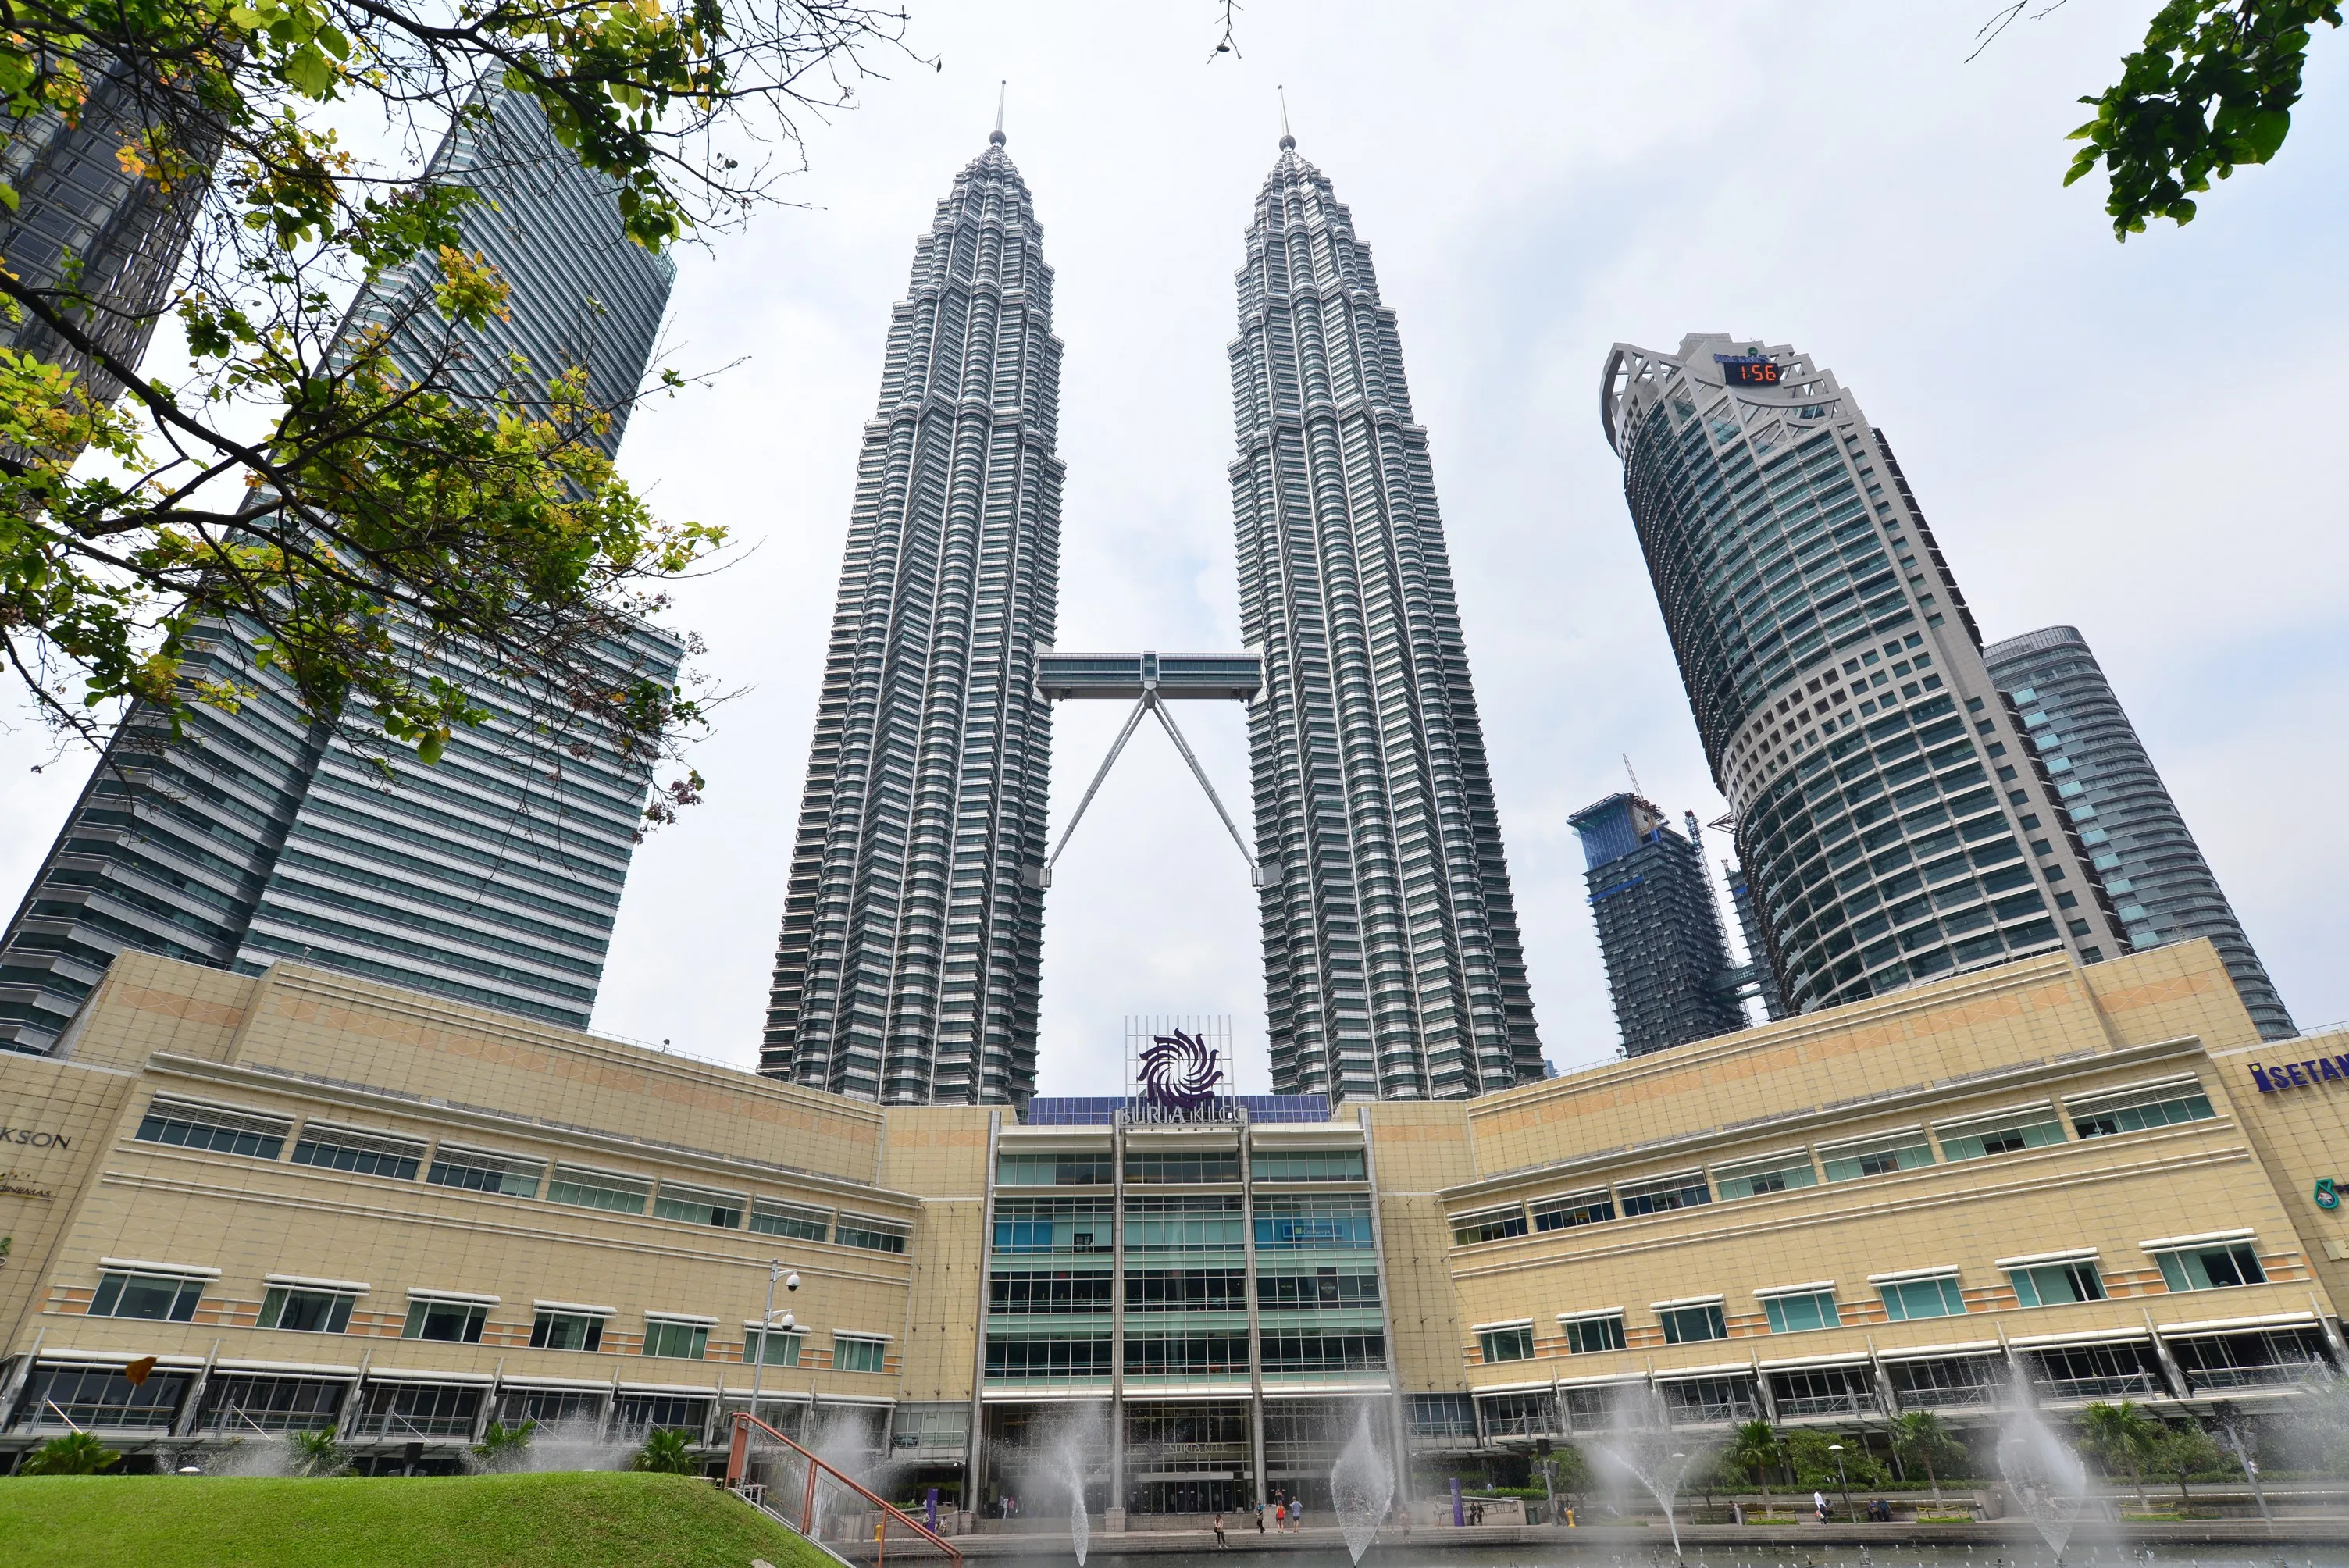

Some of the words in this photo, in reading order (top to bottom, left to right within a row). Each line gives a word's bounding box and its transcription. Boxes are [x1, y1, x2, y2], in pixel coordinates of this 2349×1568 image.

[1713, 351, 1769, 363] maxis
[1741, 364, 1777, 381] 1:56
[1119, 1106, 1185, 1124] SURIA
[1193, 1105, 1246, 1124] KLCC
[1169, 1443, 1200, 1452] SURIA
[1204, 1443, 1227, 1452] KLCC
